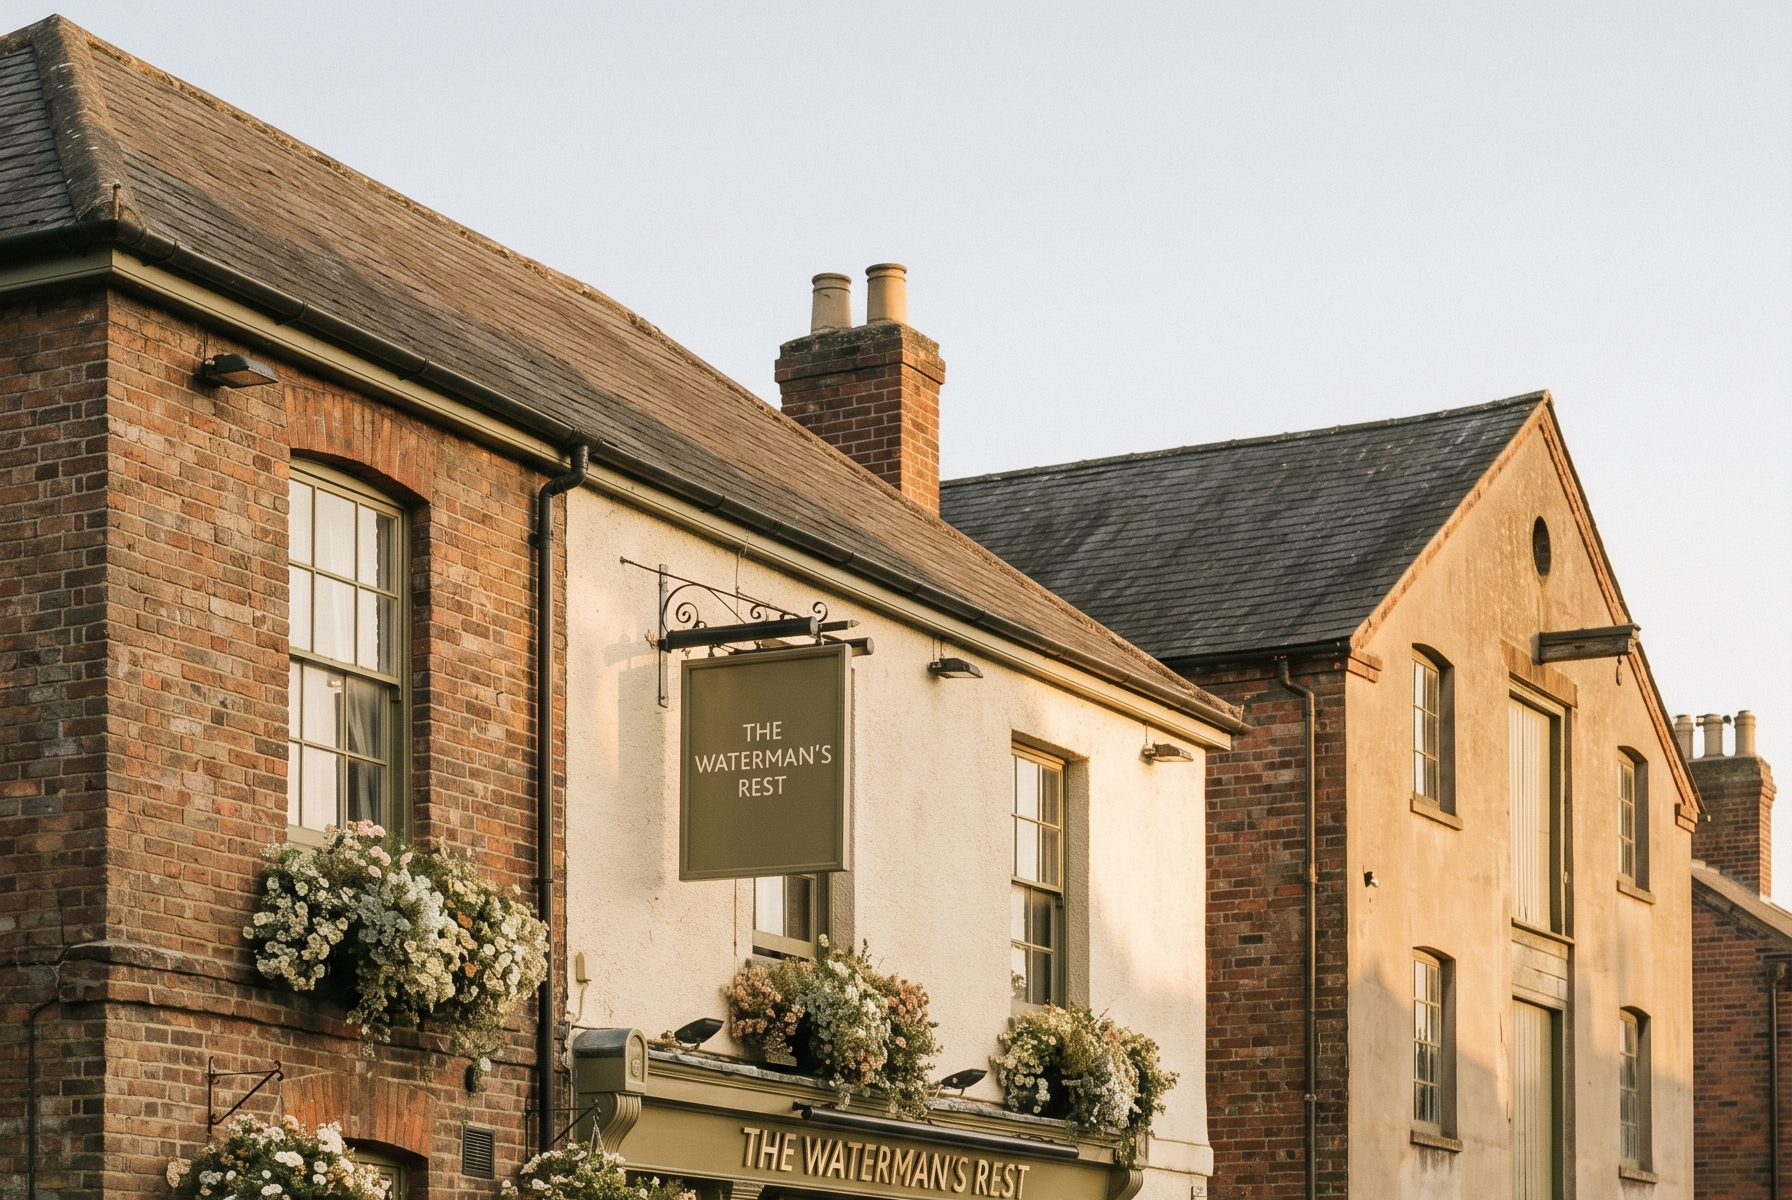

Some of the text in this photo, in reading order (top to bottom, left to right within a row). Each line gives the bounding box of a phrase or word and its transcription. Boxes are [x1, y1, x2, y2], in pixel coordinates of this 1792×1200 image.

[743, 721, 782, 742] THE
[694, 744, 832, 773] WATERMAN'S
[738, 775, 787, 798] REST
[742, 1126, 1031, 1200] THE WATERMAN'S REST
